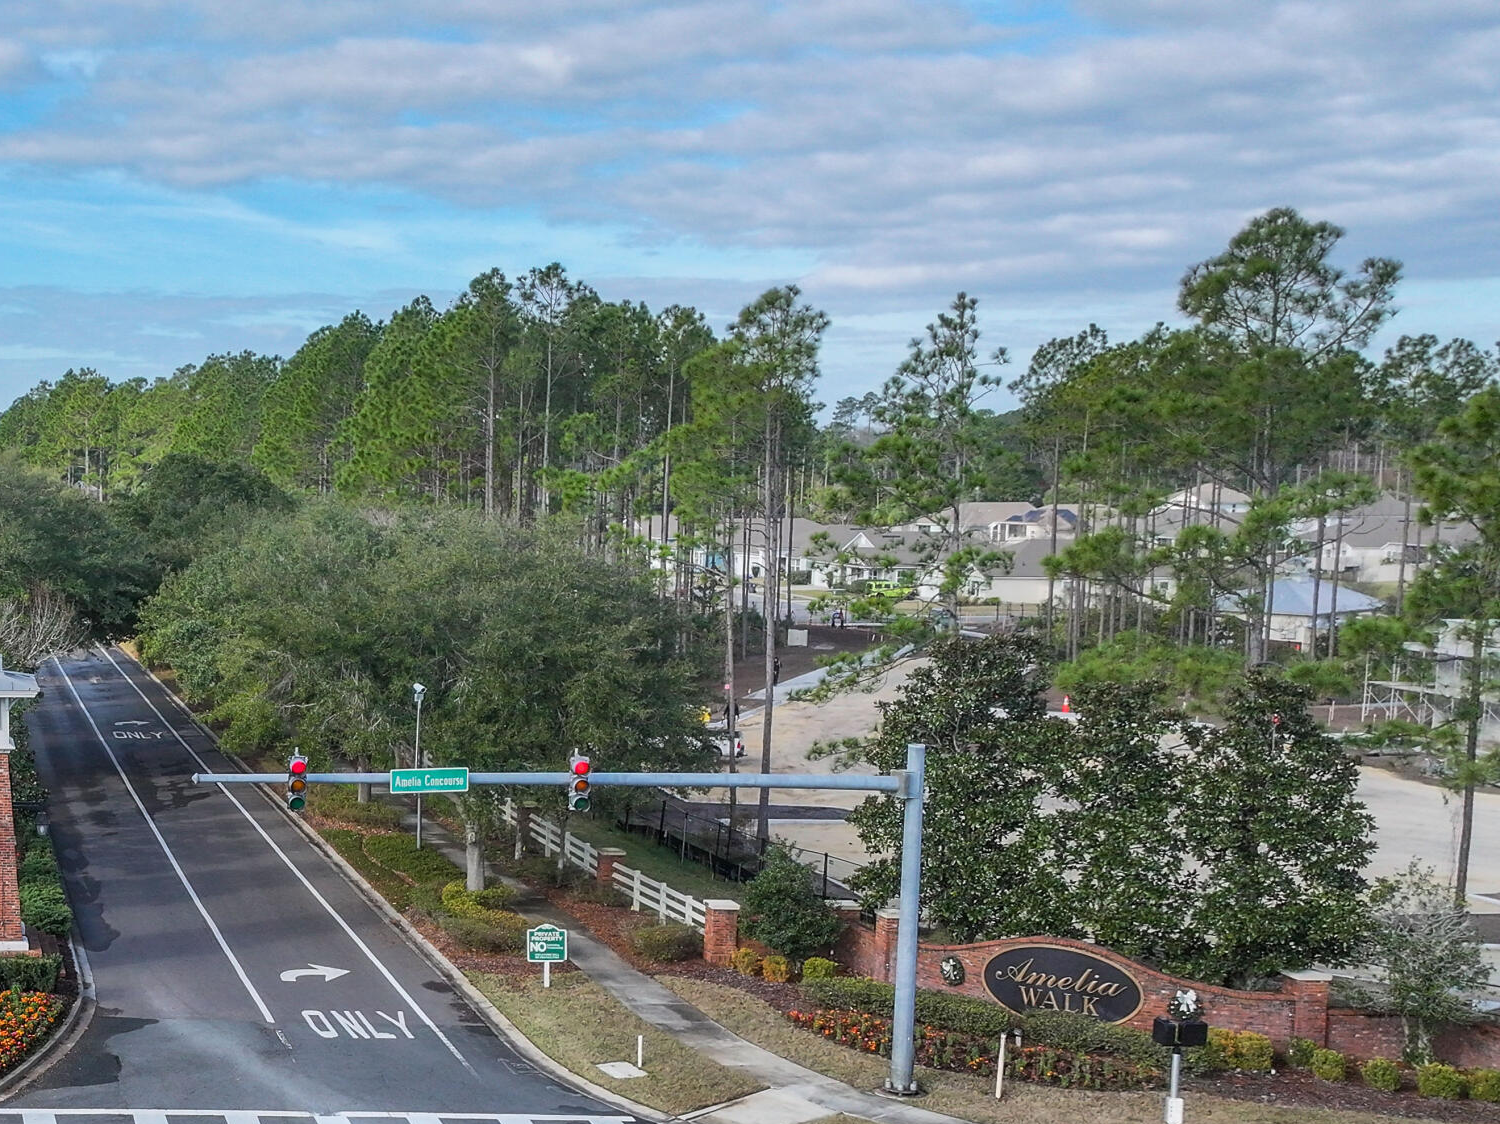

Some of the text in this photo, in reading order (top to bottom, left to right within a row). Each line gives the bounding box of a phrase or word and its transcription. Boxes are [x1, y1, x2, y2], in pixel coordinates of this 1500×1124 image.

[112, 730, 163, 739] ONLY
[394, 774, 464, 788] Amelia Concourse
[530, 941, 547, 953] NO
[995, 958, 1128, 997] Amelia
[1018, 985, 1100, 1017] WALK
[301, 1009, 415, 1039] ONLY
